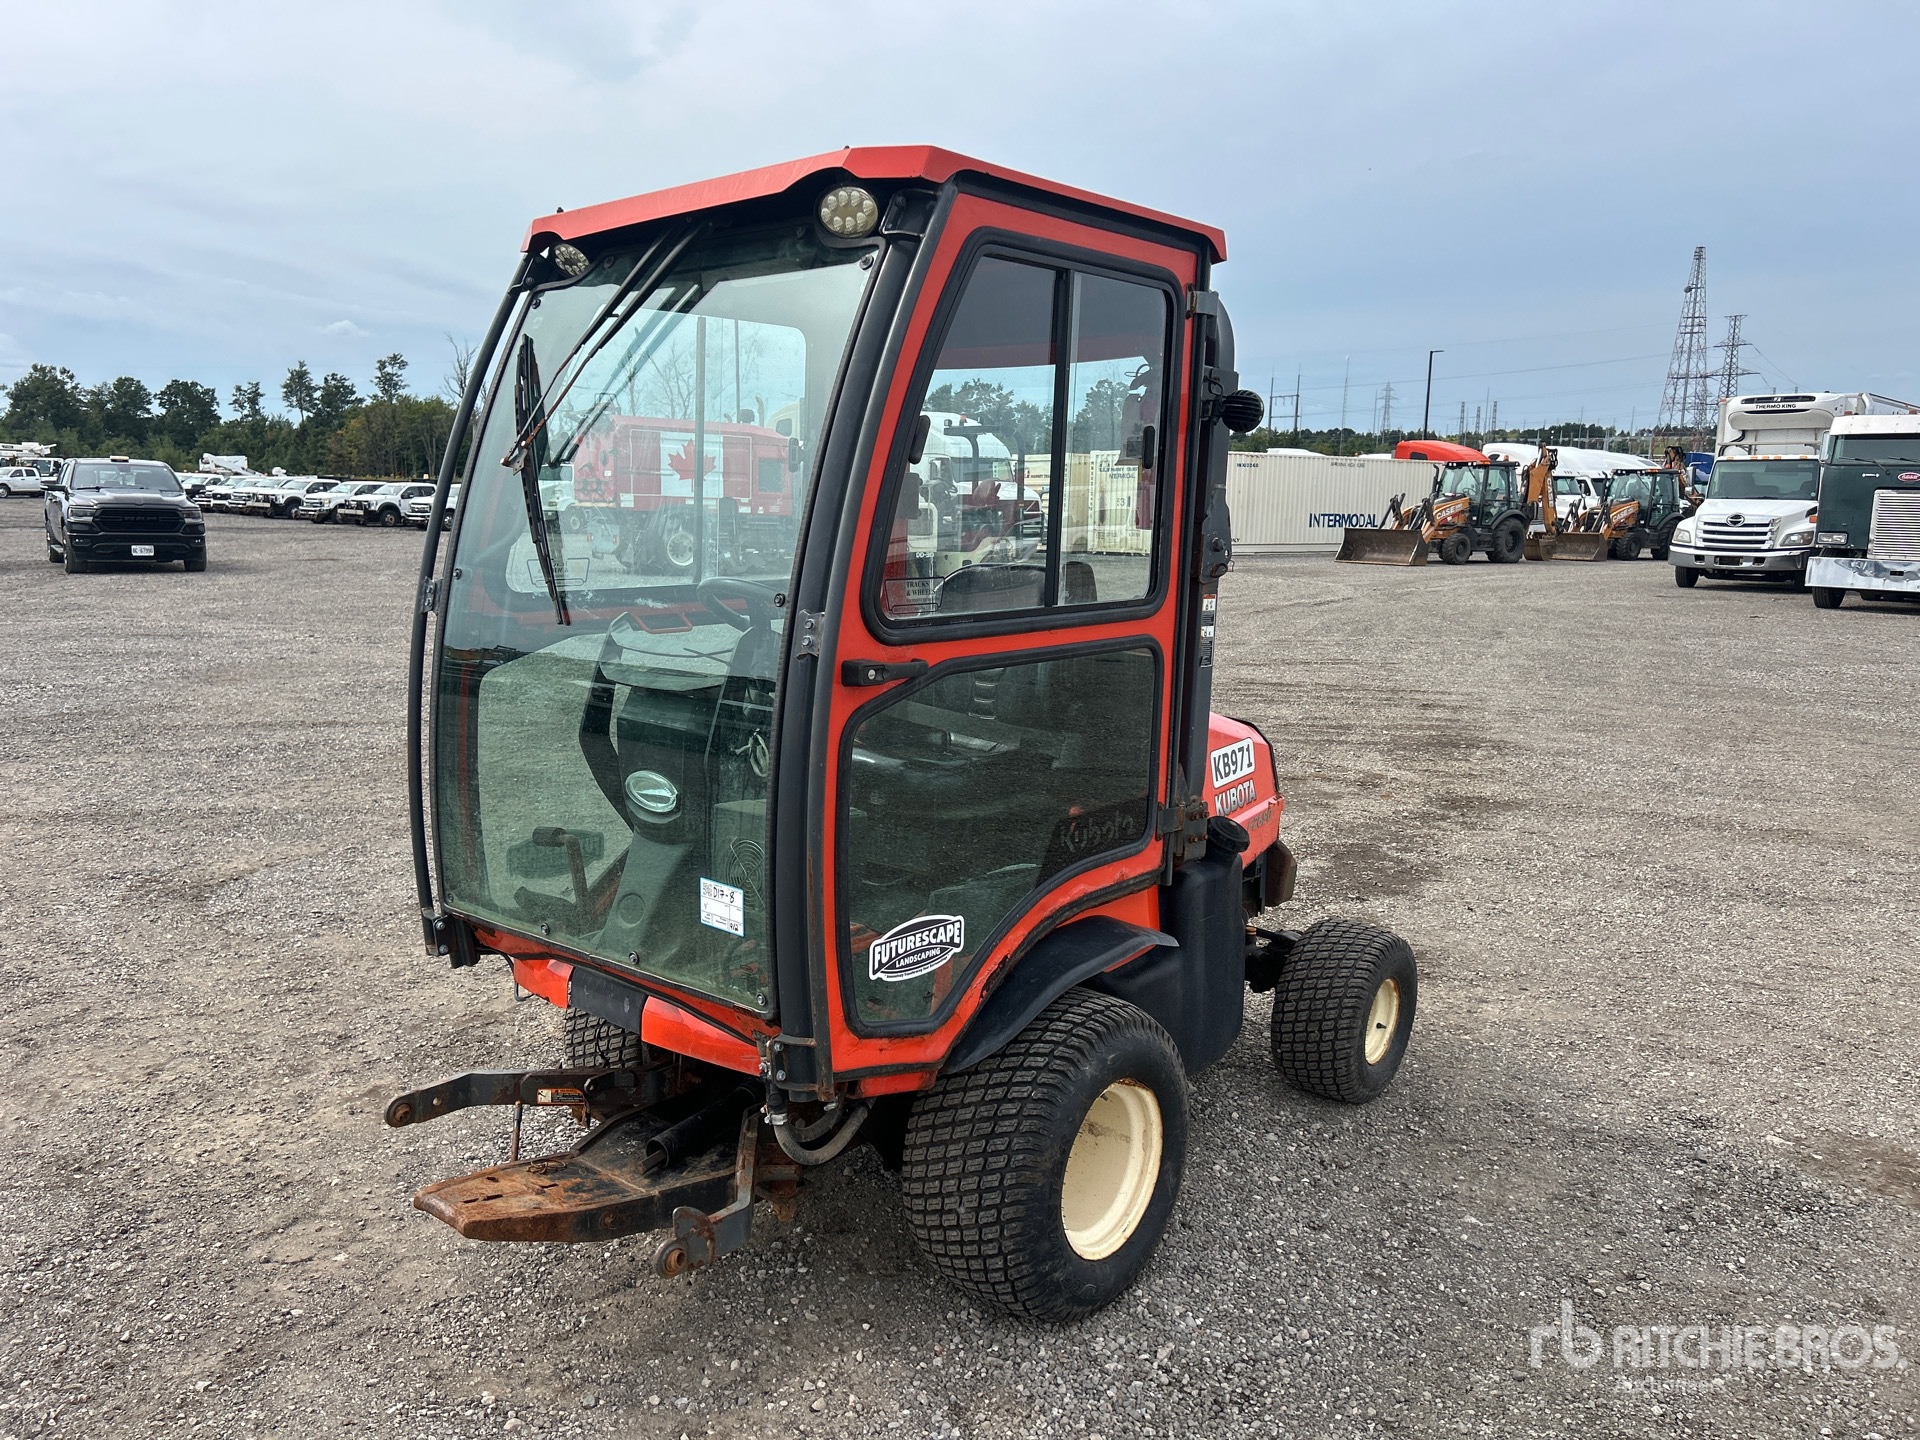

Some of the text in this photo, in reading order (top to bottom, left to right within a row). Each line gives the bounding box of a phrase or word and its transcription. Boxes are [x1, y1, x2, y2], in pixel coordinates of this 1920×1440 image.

[1309, 513, 1378, 528] INTERMODAL
[1436, 505, 1456, 520] CASE
[1213, 744, 1253, 782] KB971
[1214, 779, 1257, 817] KUBOTA
[874, 922, 961, 971] FUTURESCAPE
[895, 948, 941, 968] LANDSCAPING
